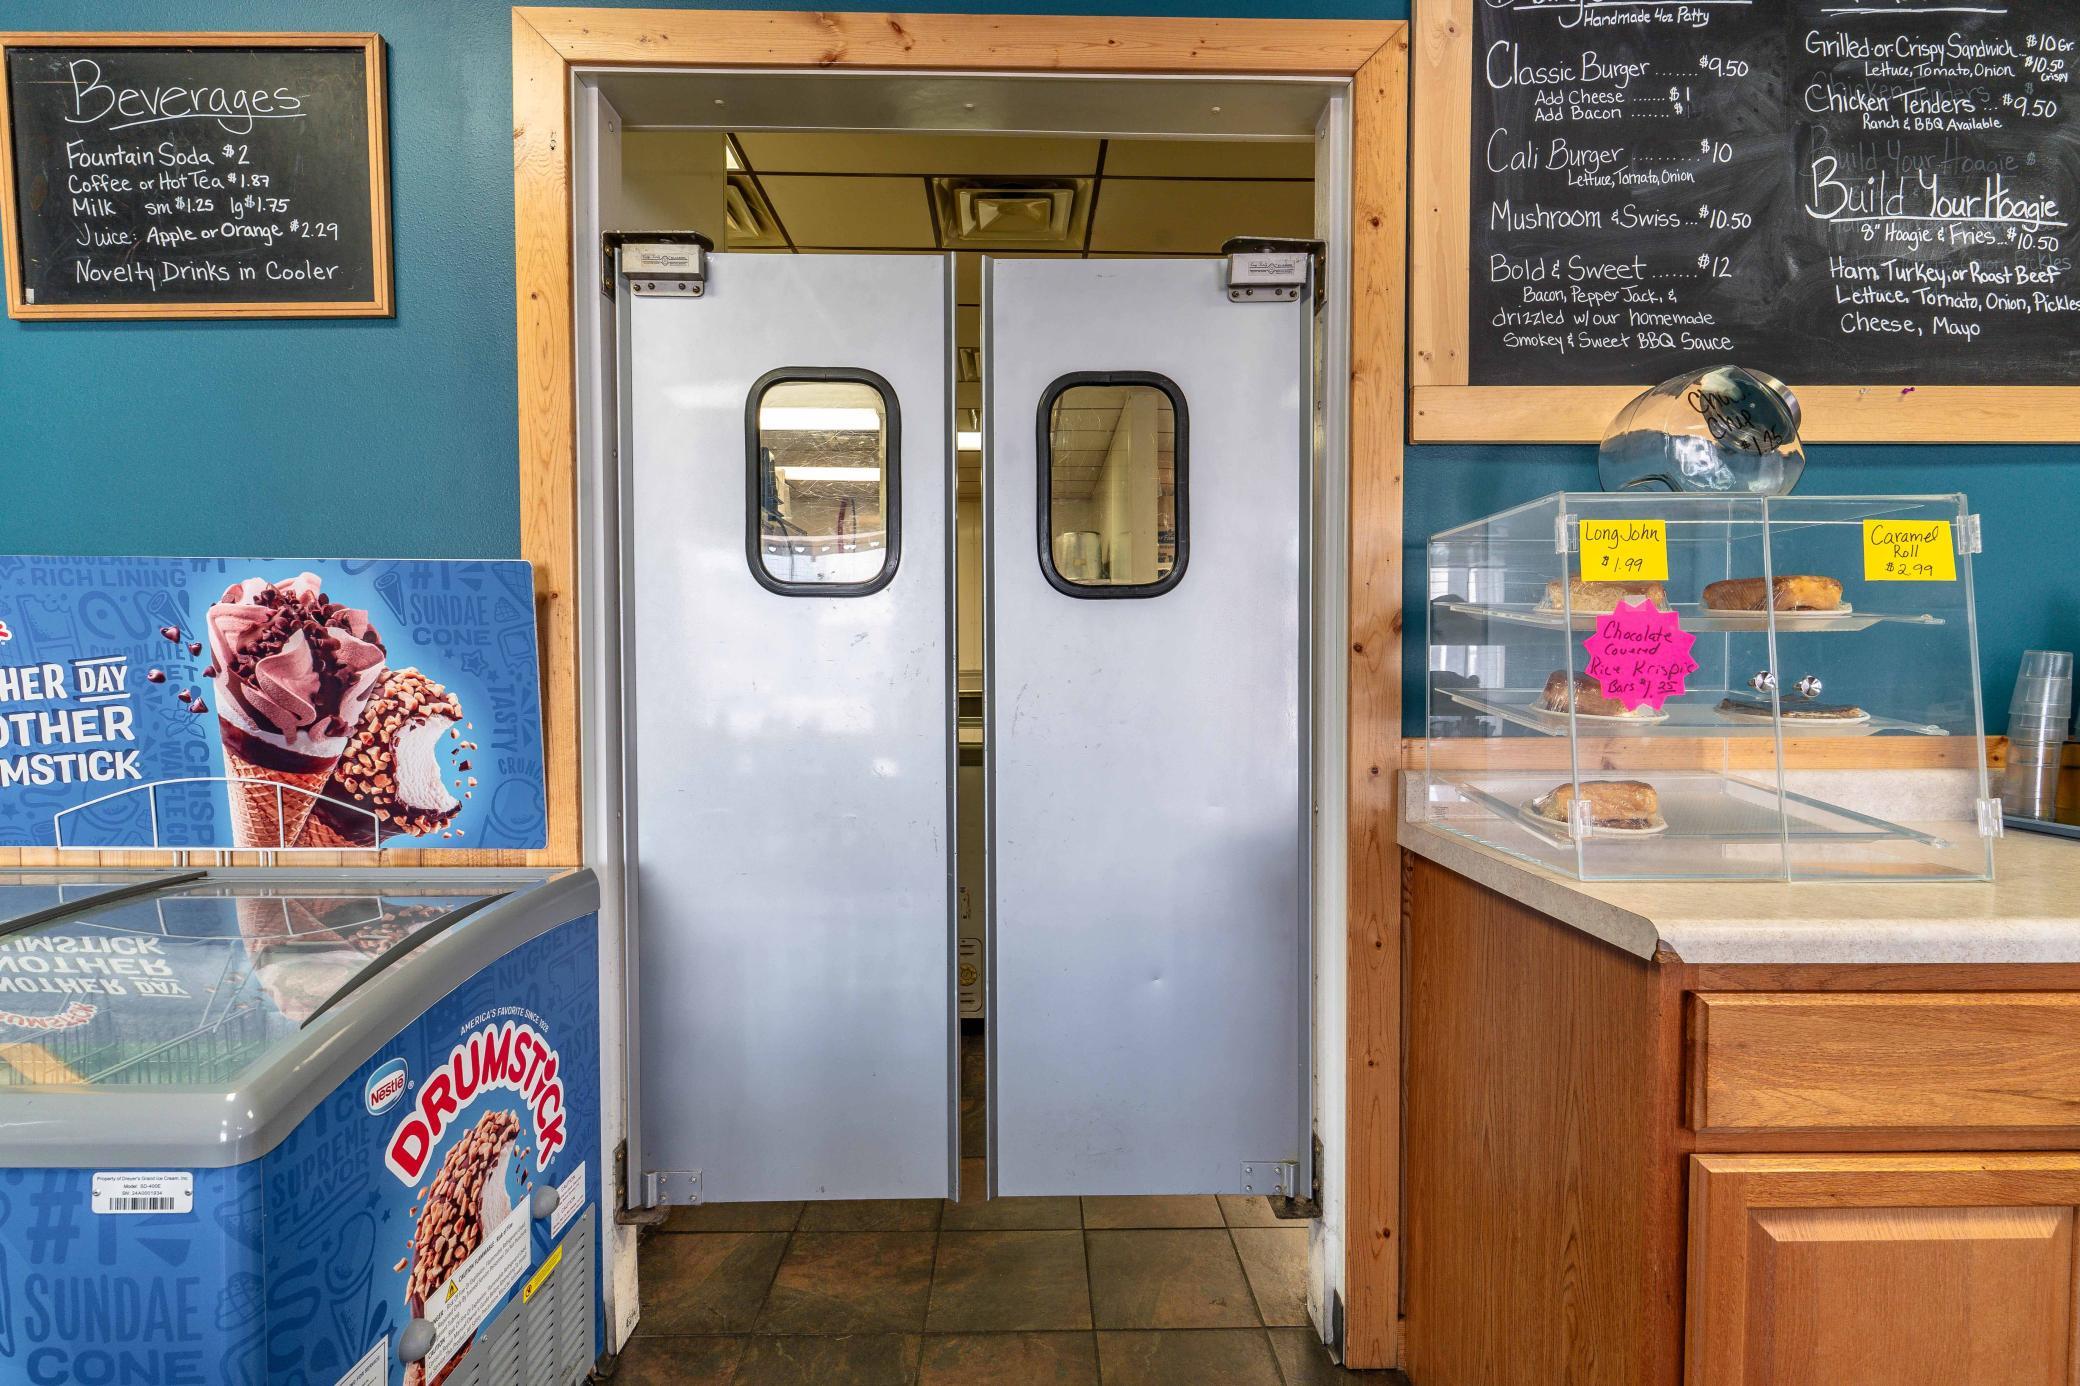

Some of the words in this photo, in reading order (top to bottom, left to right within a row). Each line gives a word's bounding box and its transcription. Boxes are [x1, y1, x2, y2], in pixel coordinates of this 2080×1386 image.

[1584, 9, 1650, 27] Handmade
[1654, 8, 1674, 23] 4oz
[1677, 7, 1710, 27] Patty
[1805, 30, 1870, 59] Grilled
[1895, 36, 1945, 66] Crispy
[1947, 32, 2018, 59] Sandwich
[2026, 34, 2056, 51] $10
[1486, 40, 1576, 88] Classic
[1580, 51, 1650, 88] Burger
[1699, 55, 1749, 77] $9.50
[1864, 61, 1913, 78] Lettuce,
[1914, 62, 1974, 78] Tomato,
[1974, 63, 2015, 77] Onion
[2025, 55, 2064, 73] $10.50
[65, 59, 302, 134] Beverages
[1535, 90, 1563, 105] Add
[1569, 90, 1625, 104] Cheese
[1804, 83, 1889, 114] Chicken
[1892, 87, 1976, 115] Tenders
[2002, 93, 2057, 118] $9.50
[1535, 107, 1563, 122] Add
[1571, 106, 1622, 120] Bacon
[1863, 113, 1900, 130] Ranch
[1903, 118, 1911, 131] &
[1914, 117, 1944, 131] BBQ
[1945, 117, 2003, 132] Available
[67, 140, 154, 169] Fountain
[159, 142, 214, 165] Soda
[222, 144, 250, 165] $2
[1487, 128, 1539, 172] Cali
[1546, 138, 1624, 173] Burger
[1701, 139, 1733, 163] $10
[68, 174, 133, 194] Coffee
[139, 179, 154, 190] or
[159, 173, 188, 191] Hot
[189, 170, 224, 190] Tea
[227, 172, 270, 188] $1.87
[1568, 171, 1615, 188] Lettuce,
[1613, 165, 1660, 186] Tomato,
[1661, 169, 1695, 183] Onion
[73, 198, 117, 216] Milk
[145, 202, 172, 215] sm
[175, 196, 214, 213] $1.25
[245, 195, 290, 213] $1.75
[1805, 156, 1904, 219] Build
[1919, 169, 1981, 217] Your
[1985, 173, 2059, 232] Hoagie
[1491, 199, 1602, 232] Mushroom
[1611, 207, 1620, 225] &
[1620, 203, 1681, 229] Swiss
[1698, 204, 1752, 229] $10.50
[76, 226, 137, 246] Juice:
[147, 227, 197, 247] Apple
[201, 228, 218, 239] or
[220, 223, 283, 246] Orange
[290, 219, 338, 241] $2.29
[1885, 223, 1932, 250] Hoagie
[1936, 226, 1944, 241] &
[2006, 228, 2059, 252] $10.50
[76, 261, 156, 291] Novelty
[163, 261, 229, 282] Drinks
[239, 263, 255, 280] in
[266, 260, 338, 280] Cooler
[1490, 253, 1546, 283] Bold
[1551, 260, 1561, 280] &
[1568, 254, 1648, 281] Sweet
[1697, 253, 1732, 278] $12
[1881, 258, 1951, 287] Turkey,
[1952, 269, 1968, 281] or
[1970, 262, 2015, 284] Roast
[2015, 265, 2061, 285] Beef
[1523, 287, 1567, 303] Bacon,
[1570, 286, 1619, 306] Pepper
[1621, 285, 1663, 304] Jack,
[1668, 289, 1677, 303] &
[1912, 287, 1982, 311] Tomato,
[1985, 293, 2031, 313] Onion,
[1492, 305, 1564, 327] drizzled
[1629, 308, 1715, 327] homemade
[1840, 313, 1922, 336] Cheese,
[1933, 317, 1981, 342] Mayo
[1503, 332, 1564, 354] Smokey
[1567, 335, 1575, 348] &
[1578, 332, 1631, 349] Sweet
[1637, 332, 1677, 349] BBQ
[1680, 332, 1735, 351] Sauce
[1585, 521, 1619, 550] Long
[1620, 522, 1660, 542] John
[1871, 524, 1939, 546] Caramel
[1601, 555, 1643, 573] $1.99
[1894, 544, 1919, 558] Roll
[1886, 562, 1933, 576] $2.99
[410, 592, 490, 627] SUNDAE
[412, 626, 492, 647] CONE
[1603, 620, 1673, 643] Chocolate
[1604, 643, 1661, 656] Covered
[78, 665, 128, 694] DAY
[1590, 657, 1620, 676] Rice
[1608, 680, 1634, 693] Bars
[489, 683, 518, 753] TASTY
[184, 740, 215, 846] CRISP
[460, 1008, 496, 1036] AMERICA'S
[497, 1006, 524, 1016] FAVORITE
[371, 1074, 404, 1106] Nestlé
[391, 1028, 564, 1178] DRUMSTICK
[272, 1116, 370, 1209] SUPREME
[273, 1151, 370, 1235] FLAVOR
[25, 1273, 203, 1343] SUNDAE
[27, 1347, 205, 1386] CONE
